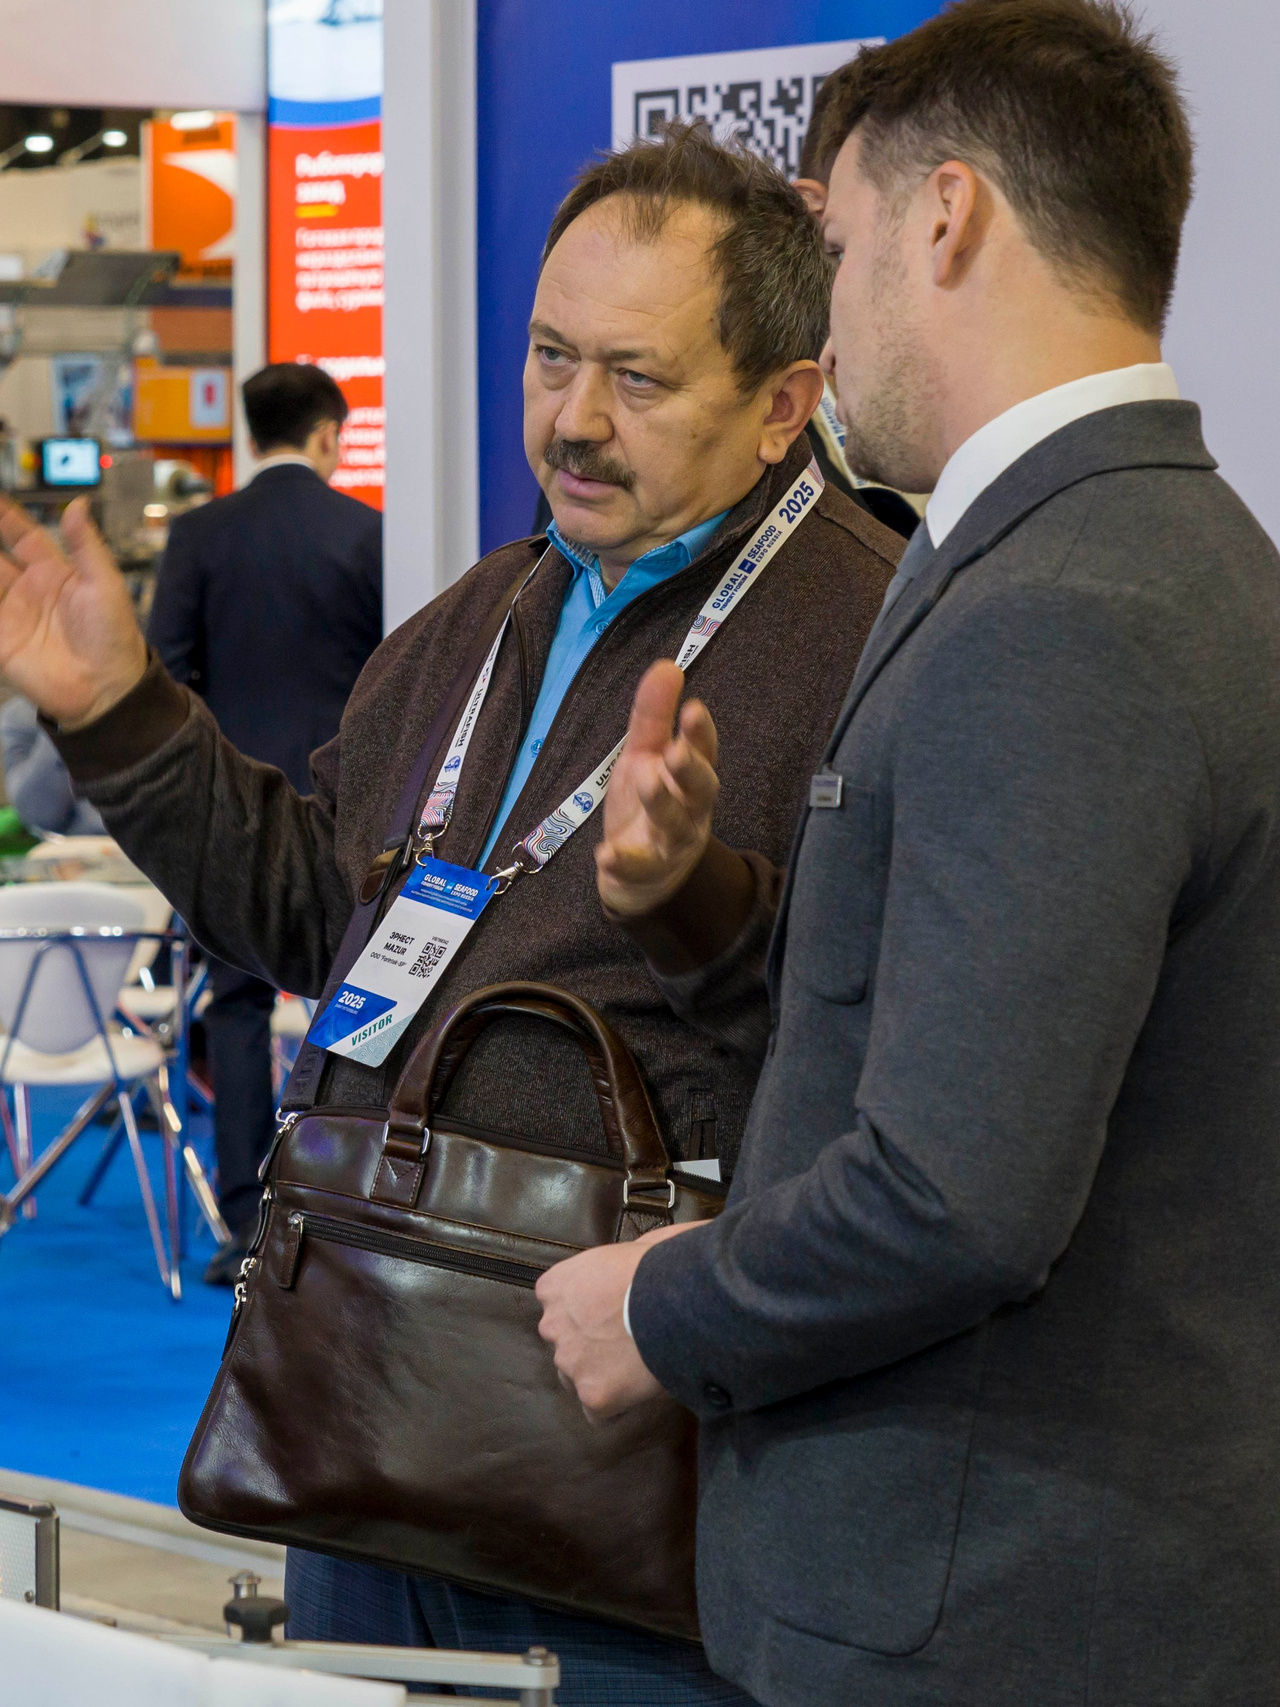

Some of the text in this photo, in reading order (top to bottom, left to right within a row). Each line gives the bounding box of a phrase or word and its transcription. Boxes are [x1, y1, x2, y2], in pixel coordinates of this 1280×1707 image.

[712, 572, 743, 609] GLOBAL
[747, 524, 777, 559] SEAFOOD
[779, 481, 814, 524] 2025
[458, 688, 483, 747] ULTRAFISH
[424, 874, 447, 886] GLOBAL
[453, 883, 479, 897] SEAFOOD
[383, 942, 407, 956] MAZUR
[389, 931, 415, 945] ЭРНЕСТ
[338, 990, 367, 1010] 2025
[351, 1014, 393, 1046] VISITOR
